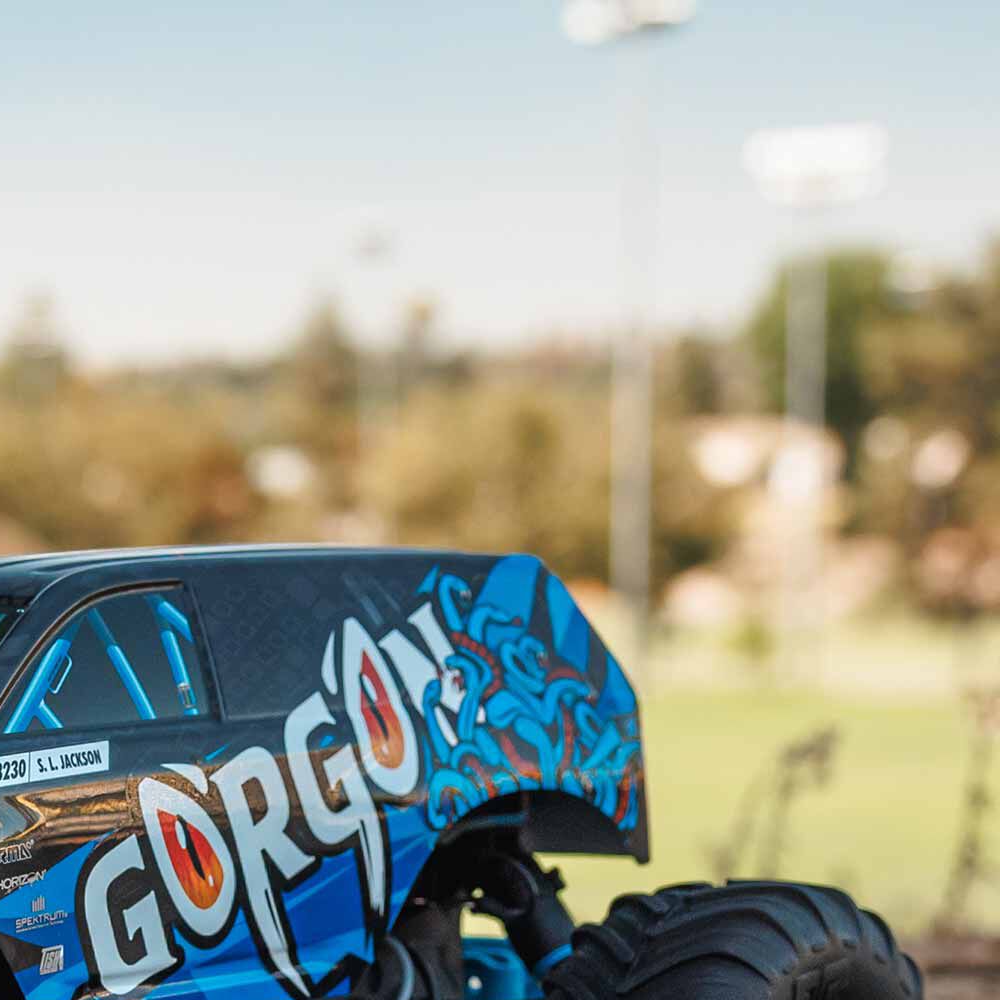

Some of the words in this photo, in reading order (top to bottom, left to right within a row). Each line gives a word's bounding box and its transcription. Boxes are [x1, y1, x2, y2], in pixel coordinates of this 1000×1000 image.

[36, 758, 48, 774] S.
[48, 756, 59, 772] L.
[60, 749, 102, 770] JACKSON
[84, 601, 486, 998] GORGON
[15, 910, 68, 929] SPEKTRUM
